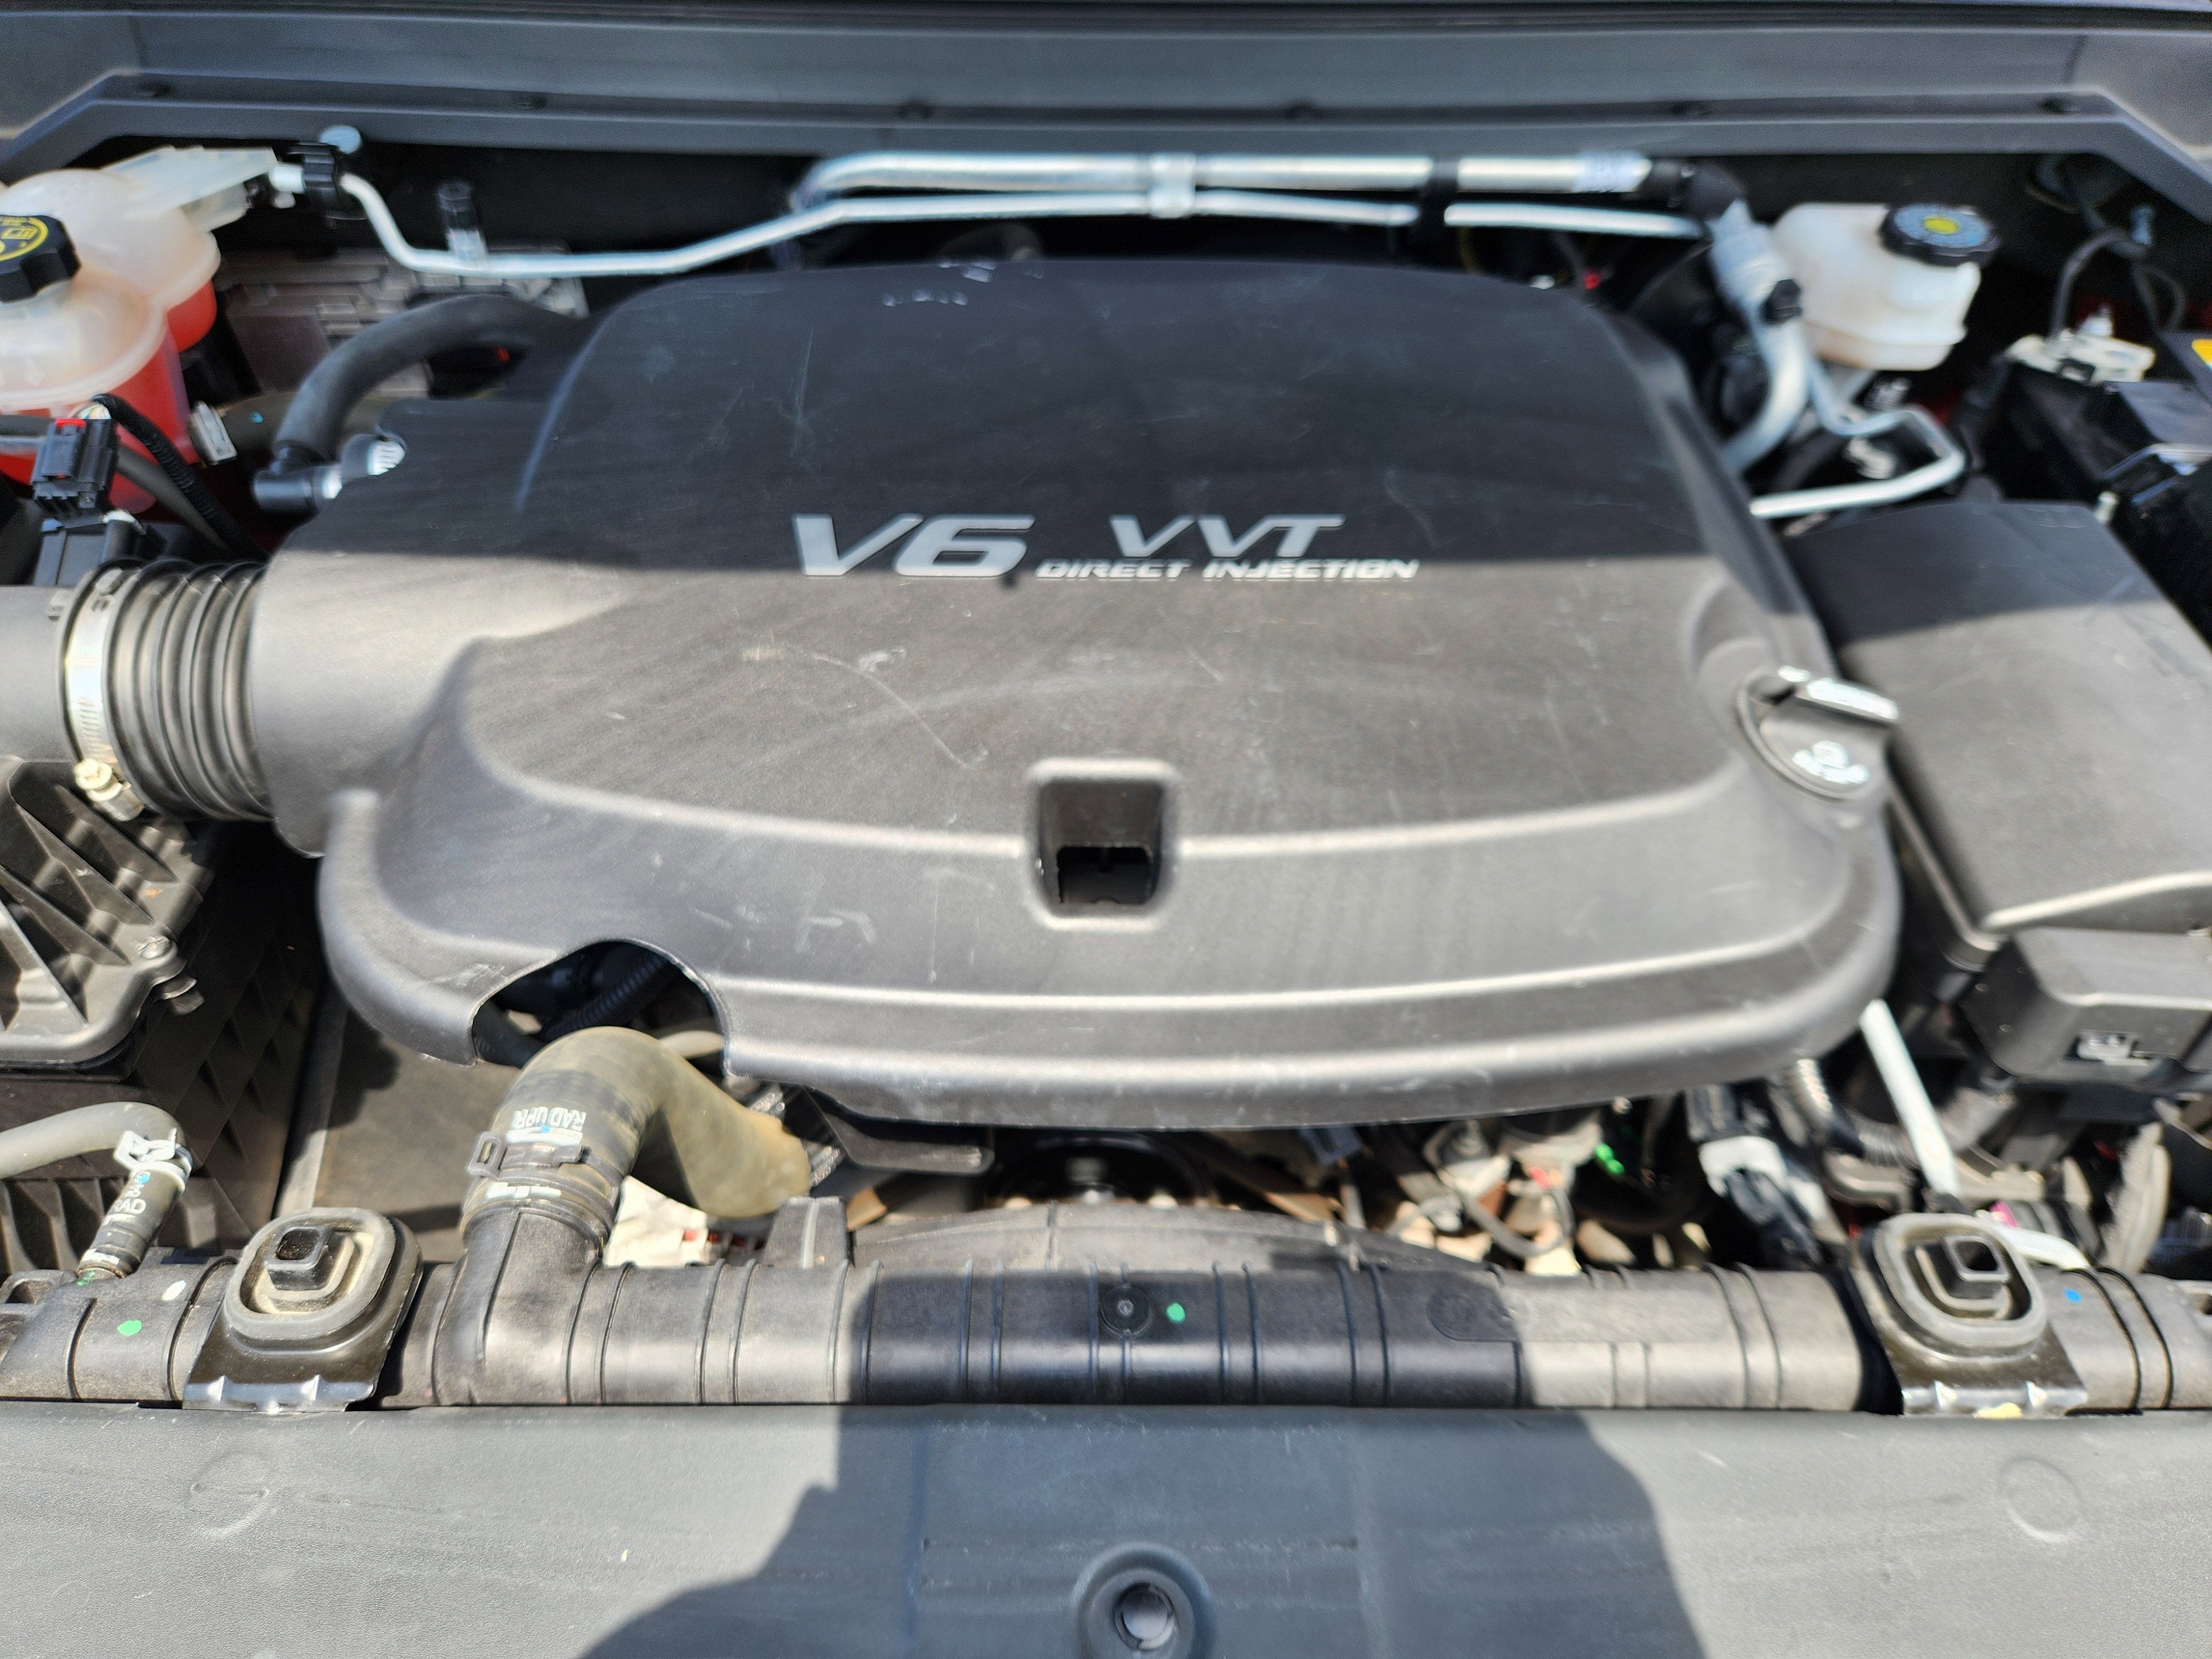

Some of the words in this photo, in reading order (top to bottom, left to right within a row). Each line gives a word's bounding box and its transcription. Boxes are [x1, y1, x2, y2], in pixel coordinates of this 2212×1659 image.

[791, 513, 1036, 576] V6
[1109, 514, 1345, 557] VVT
[1035, 559, 1192, 578] DIRECT
[1202, 559, 1420, 579] INJECTION
[549, 1107, 586, 1131] RAD
